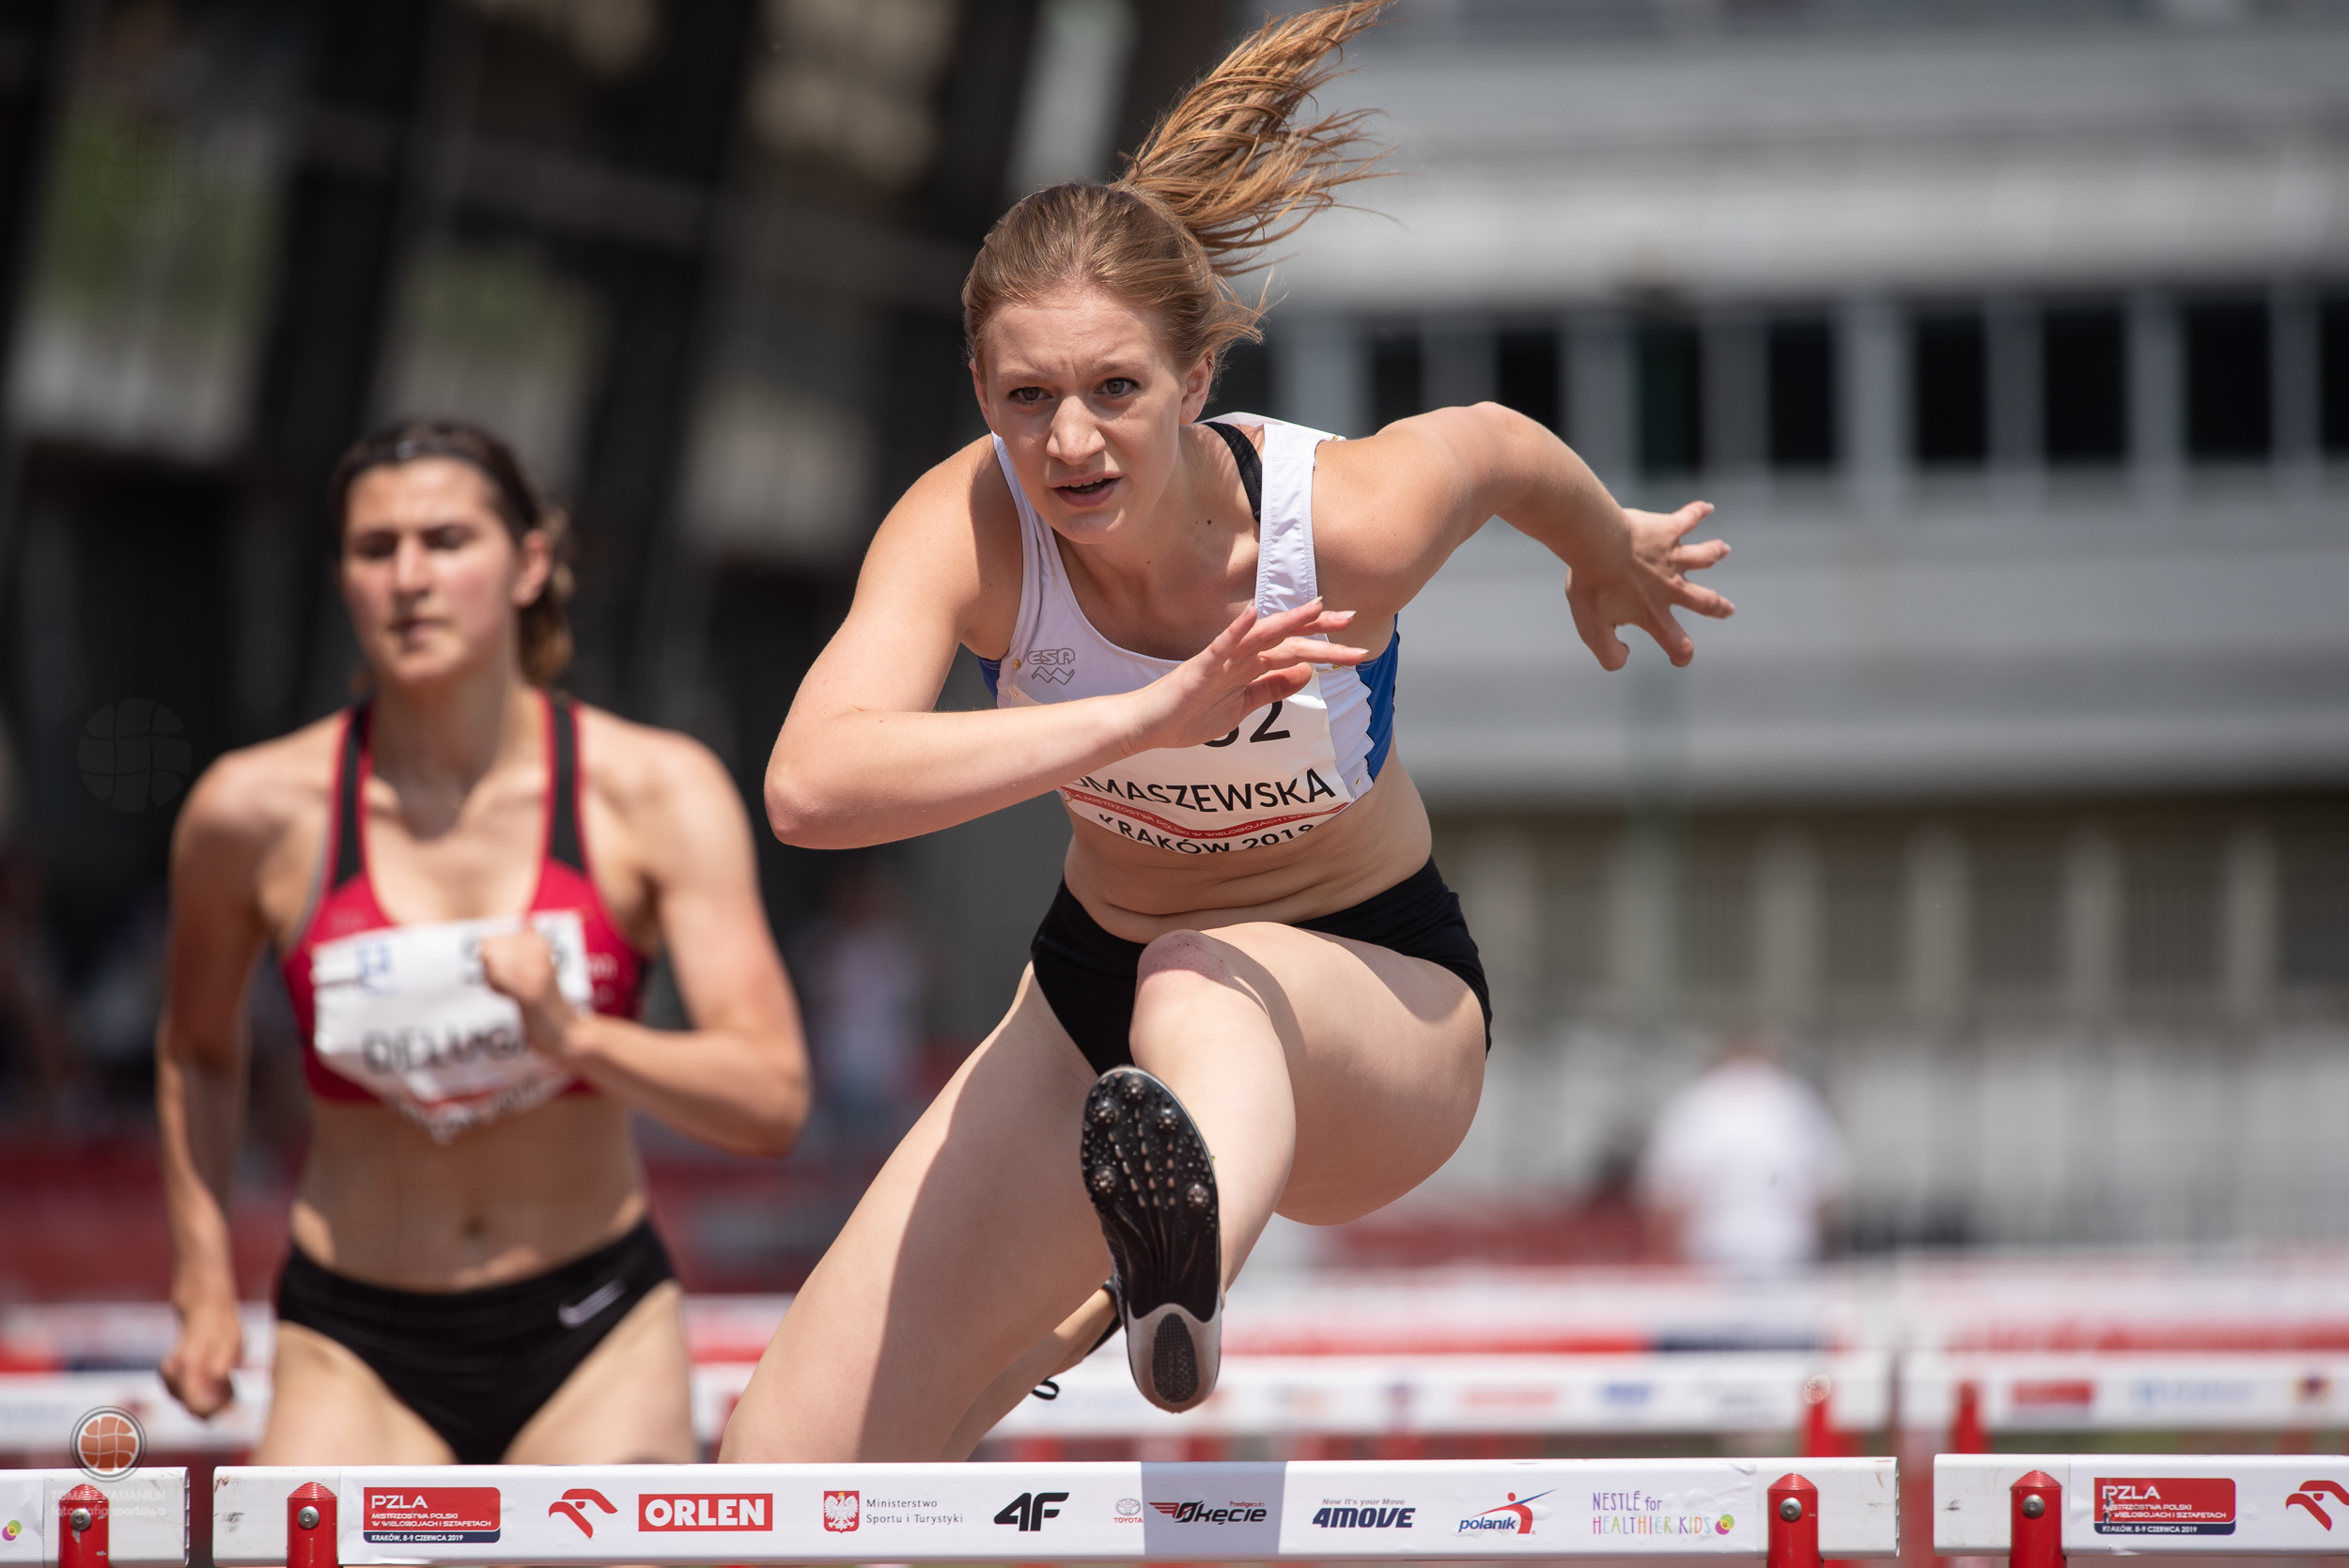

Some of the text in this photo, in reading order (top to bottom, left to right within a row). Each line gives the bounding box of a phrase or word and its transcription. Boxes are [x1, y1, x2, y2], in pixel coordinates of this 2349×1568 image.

[1156, 818, 1190, 836] POLSKI
[2102, 1485, 2161, 1499] PZLA
[371, 1495, 428, 1509] PZLA
[866, 1498, 938, 1508] Ministerstwo
[1644, 1497, 1662, 1511] for
[645, 1498, 765, 1527] ORLEN
[866, 1514, 902, 1525] Sportu
[914, 1514, 963, 1525] Turystyki
[993, 1492, 1069, 1531] 4F
[1312, 1508, 1416, 1528] 4MOVE
[1458, 1516, 1517, 1532] polanik
[1593, 1515, 1711, 1535] HEALTHIER KIDS
